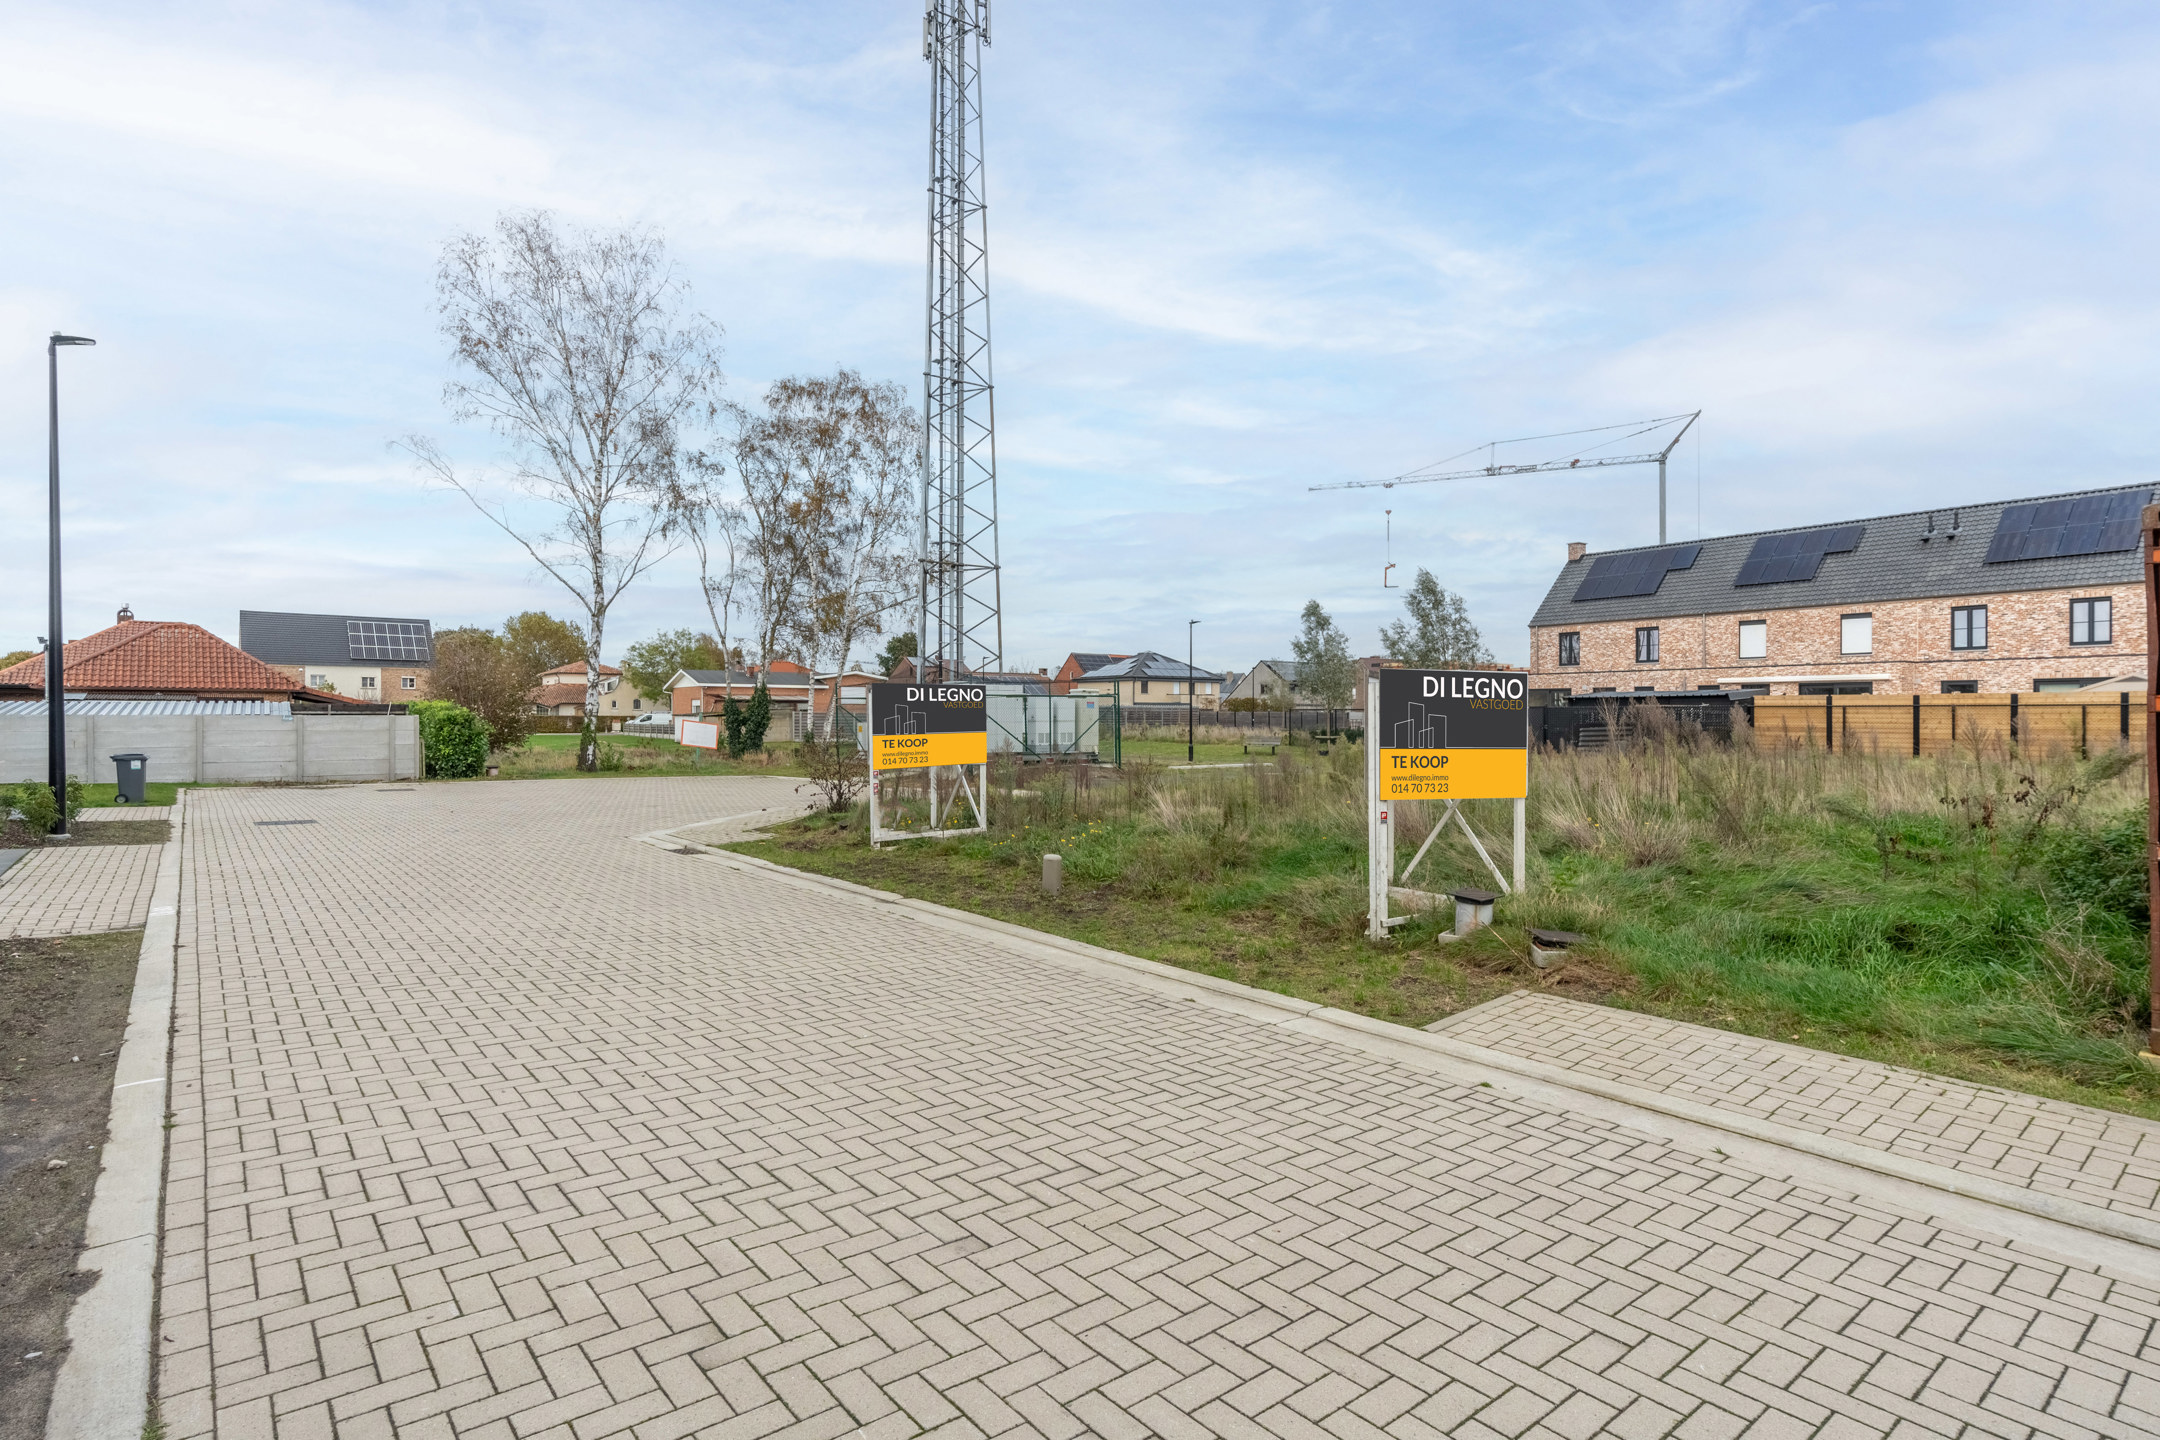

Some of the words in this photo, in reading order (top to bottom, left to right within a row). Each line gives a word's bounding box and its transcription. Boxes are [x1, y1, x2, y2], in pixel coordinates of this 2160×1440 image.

[1423, 676, 1445, 698] DI
[1451, 677, 1524, 699] LEGNO
[907, 688, 924, 701] DI
[929, 688, 983, 701] LEGNO
[1469, 699, 1524, 710] VASTGOED
[882, 739, 895, 748] TE
[897, 738, 928, 748] KOOP
[882, 758, 897, 766] 014
[898, 757, 908, 765] 70
[909, 756, 918, 764] 73
[919, 756, 929, 764] 23
[1391, 755, 1407, 769] TE
[1410, 755, 1449, 769] KOOP
[1391, 774, 1449, 782] www.dilegno.immo
[1391, 783, 1409, 793] 014
[1411, 783, 1423, 793] 70
[1424, 782, 1436, 793] 73
[1437, 782, 1449, 793] 23
